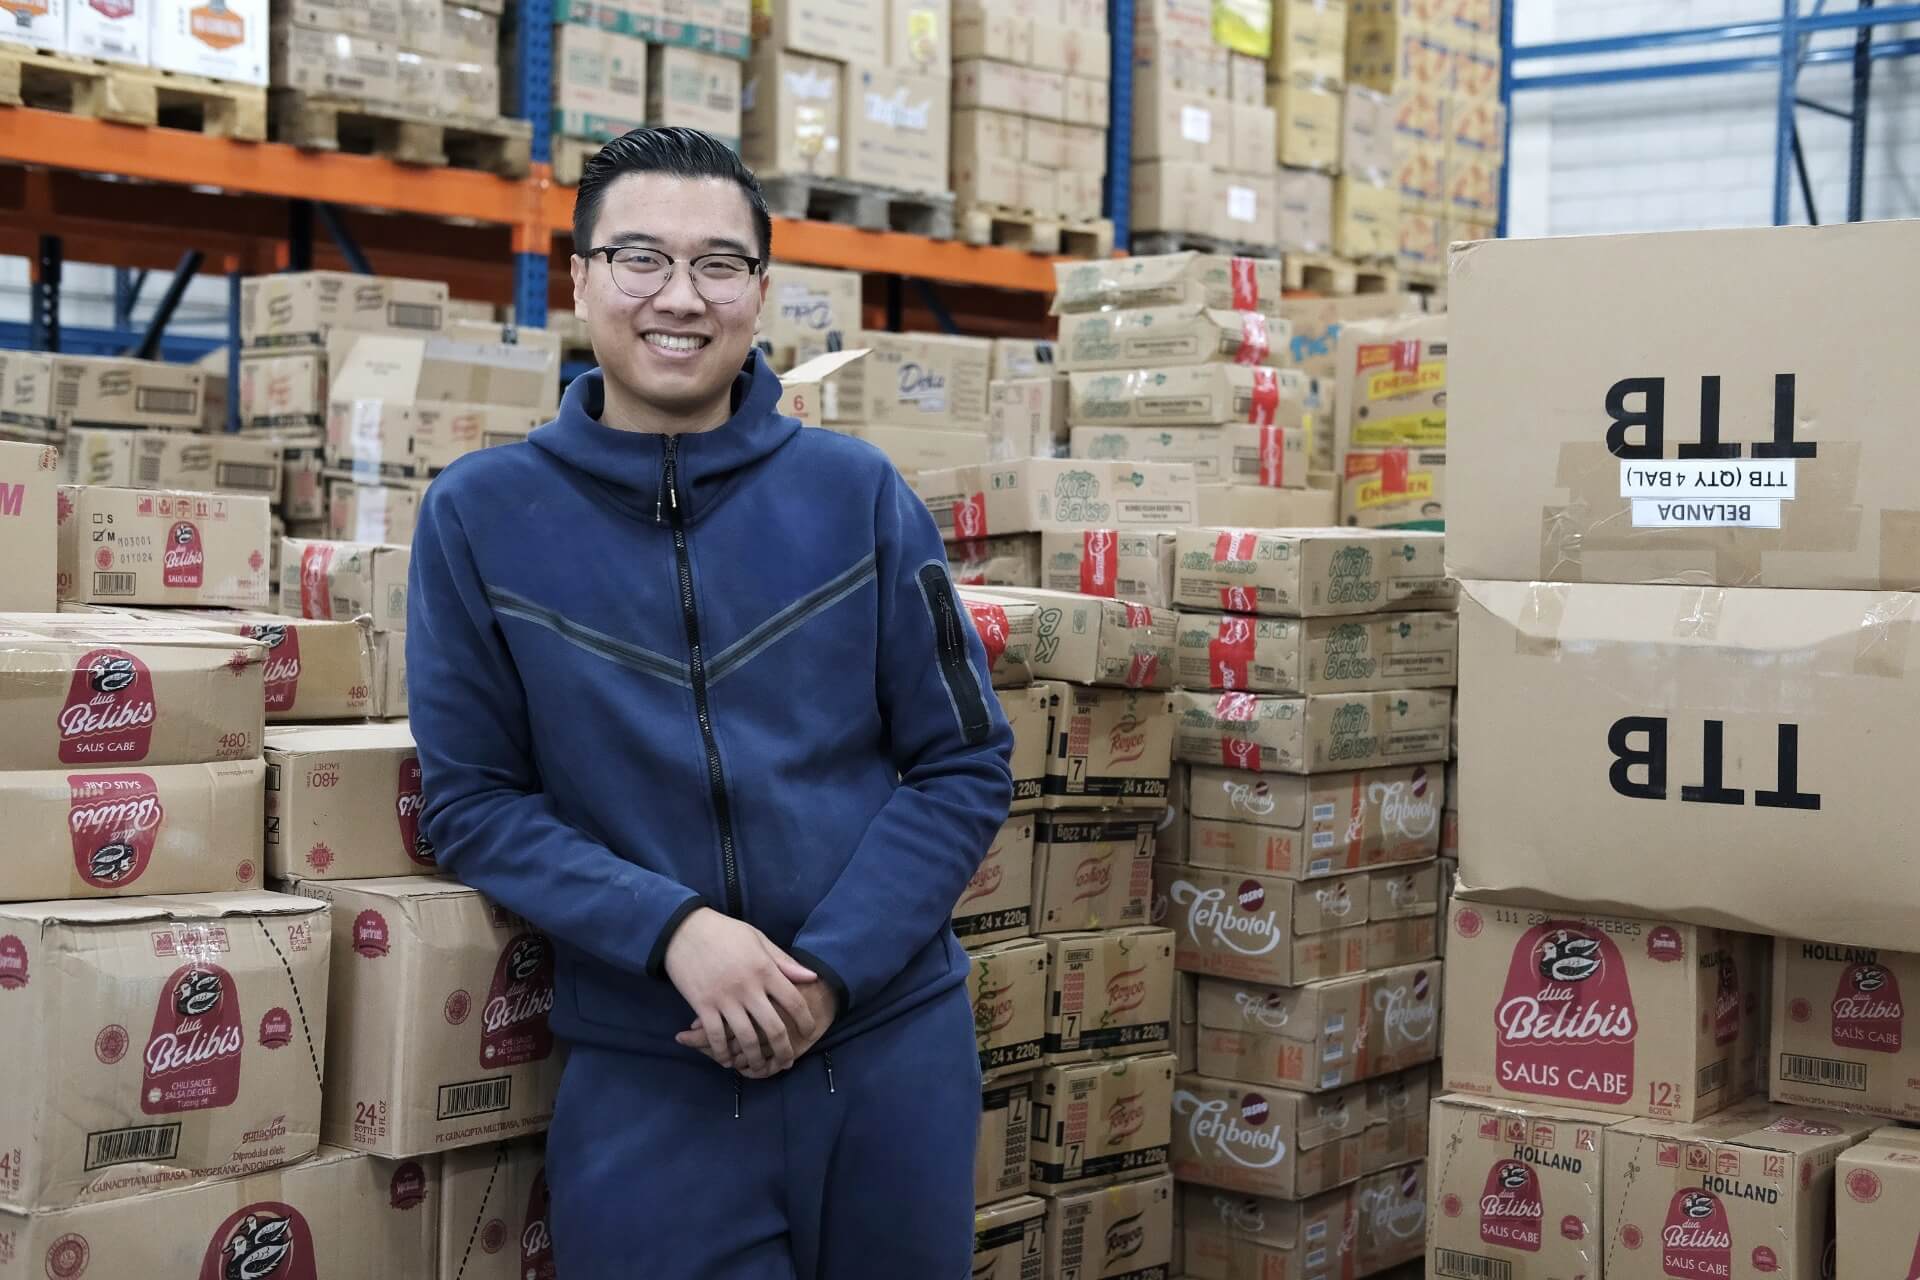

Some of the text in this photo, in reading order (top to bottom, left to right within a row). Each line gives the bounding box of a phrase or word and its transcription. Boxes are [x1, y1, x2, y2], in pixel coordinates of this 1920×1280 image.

[1605, 373, 1817, 459] TTB
[1627, 467, 1788, 487] TTB (QTY 4 BAL)
[107, 515, 114, 524] S
[1658, 504, 1751, 521] BELANDA
[107, 532, 115, 541] M
[90, 693, 115, 706] dua
[61, 702, 152, 737] Belibis
[76, 741, 135, 753] SAUS CABE
[218, 733, 245, 748] 480
[1110, 733, 1145, 754] Royco
[312, 772, 339, 787] 480
[1074, 759, 1083, 781] 7
[1018, 781, 1041, 797] 220g
[1124, 780, 1135, 793] 24
[1145, 781, 1165, 796] 220g
[73, 798, 160, 833] Belibis
[1138, 835, 1147, 855] 7
[980, 914, 992, 929] 24
[1004, 911, 1027, 928] 220g
[1170, 880, 1281, 956] Tehbotol
[1496, 909, 1519, 924] 111
[1803, 943, 1877, 965] HOLLAND
[1109, 980, 1145, 1005] Royco
[1537, 983, 1574, 1001] dua
[1499, 996, 1632, 1040] Belibis
[1833, 998, 1901, 1019] Belibis
[176, 1018, 202, 1034] dua
[1067, 1016, 1077, 1037] 7
[1120, 1028, 1131, 1042] 24
[1143, 1025, 1165, 1041] 220g
[1834, 1027, 1899, 1045] SAUS CABE
[147, 1026, 240, 1073] Belibis
[992, 1051, 1004, 1065] 24
[1016, 1044, 1041, 1061] 220g
[172, 1078, 212, 1090] CHILI SAUCE
[1502, 1060, 1628, 1095] SAUS CABE
[165, 1086, 217, 1100] SALSA DE CHILE
[1648, 1081, 1673, 1108] 12
[355, 1101, 377, 1126] 24
[1013, 1099, 1023, 1121] 7
[354, 1124, 377, 1136] BOTTLE
[445, 1127, 483, 1143] GUNACIPTA
[1173, 1089, 1286, 1168] Tehbotol
[1070, 1145, 1080, 1166] 7
[1513, 1144, 1582, 1174] HOLLAND
[1763, 1154, 1779, 1173] 12
[1702, 1175, 1778, 1205] HOLLAND
[1481, 1195, 1542, 1217] Belibis
[1482, 1223, 1540, 1244] SAUS CABE
[1682, 1220, 1700, 1229] dua
[1028, 1231, 1037, 1254] 7
[1664, 1225, 1730, 1249] Belibis
[1665, 1255, 1729, 1276] SAUS CABE
